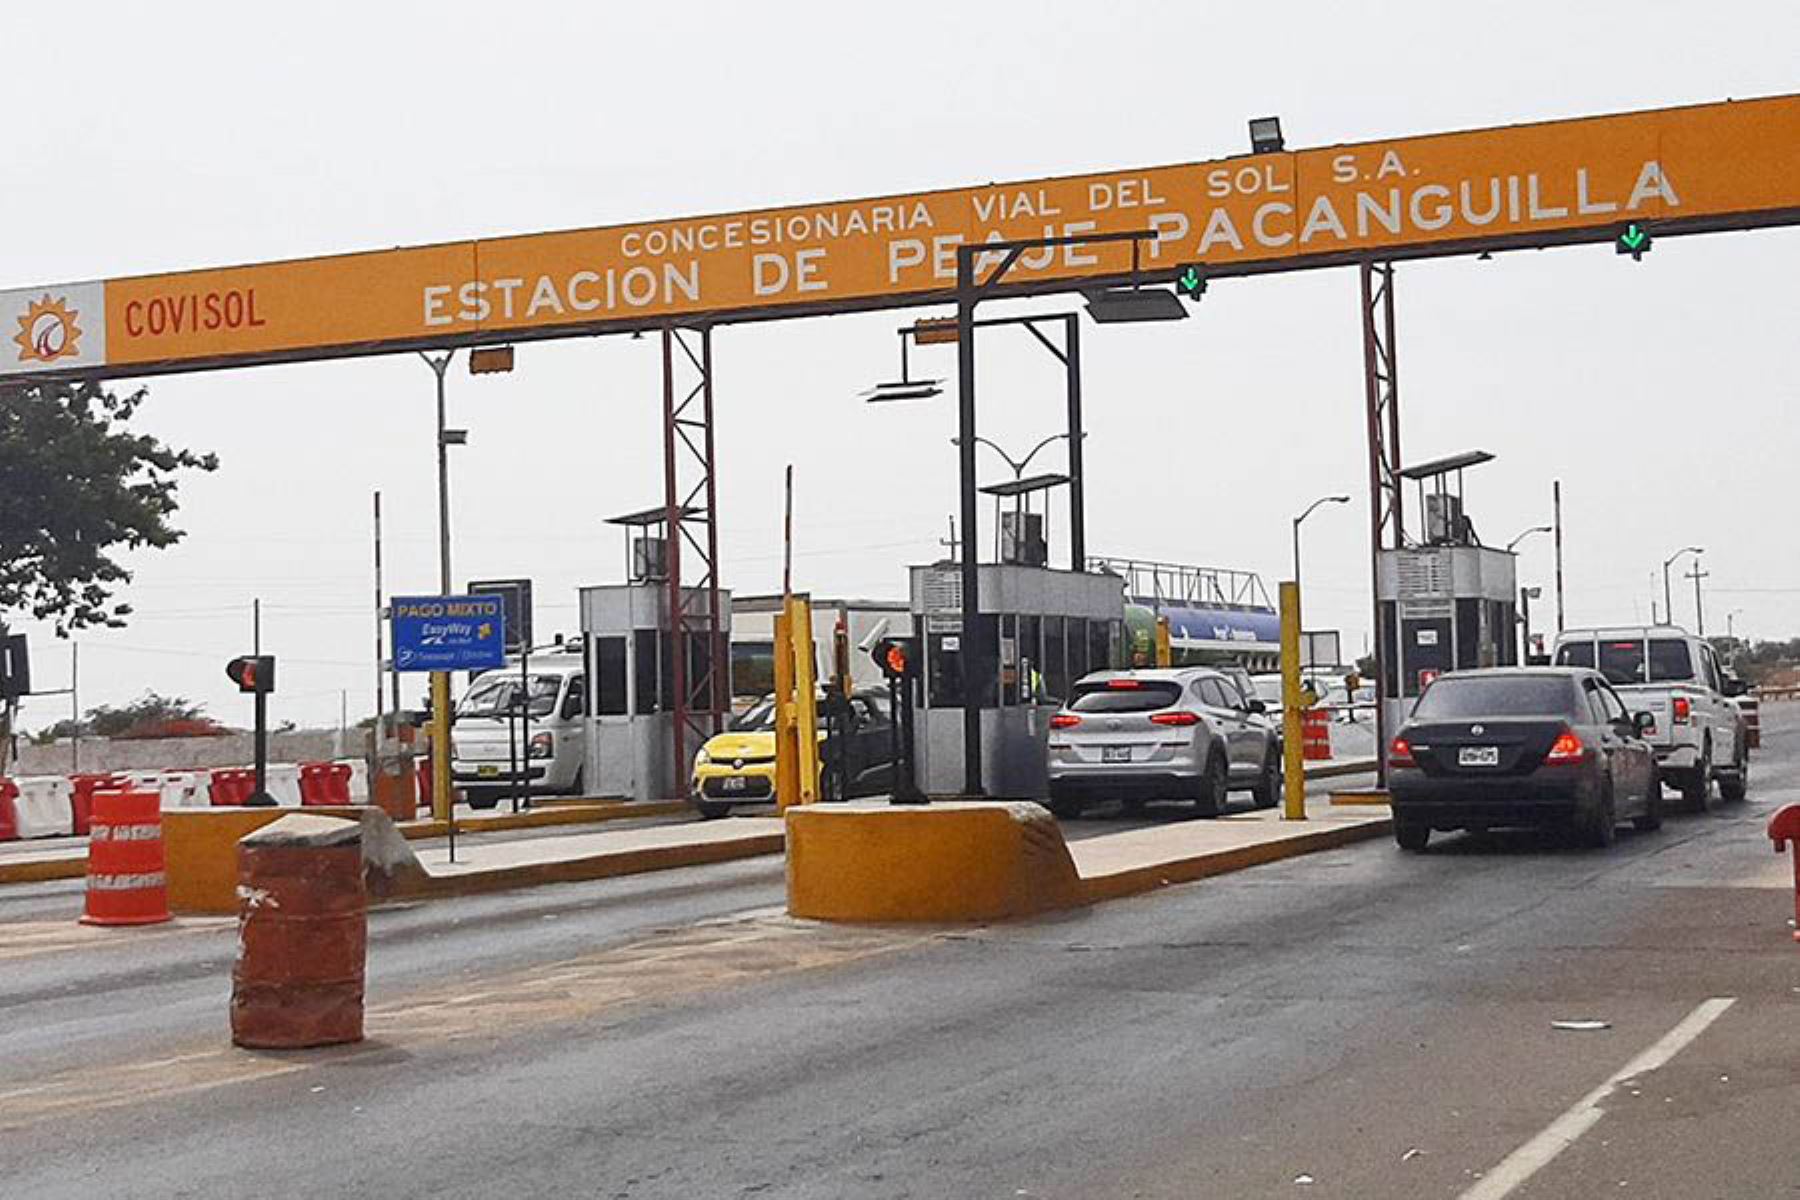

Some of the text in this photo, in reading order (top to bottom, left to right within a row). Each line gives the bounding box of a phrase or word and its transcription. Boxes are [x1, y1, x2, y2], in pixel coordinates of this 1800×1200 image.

[621, 150, 1420, 257] CONCESIONARIA VIAL DEL SOL S.A.
[423, 160, 1681, 326] ESTACION DE PEAJE PACANGUILLA
[126, 288, 266, 336] COVISOL
[398, 603, 444, 617] PAGO
